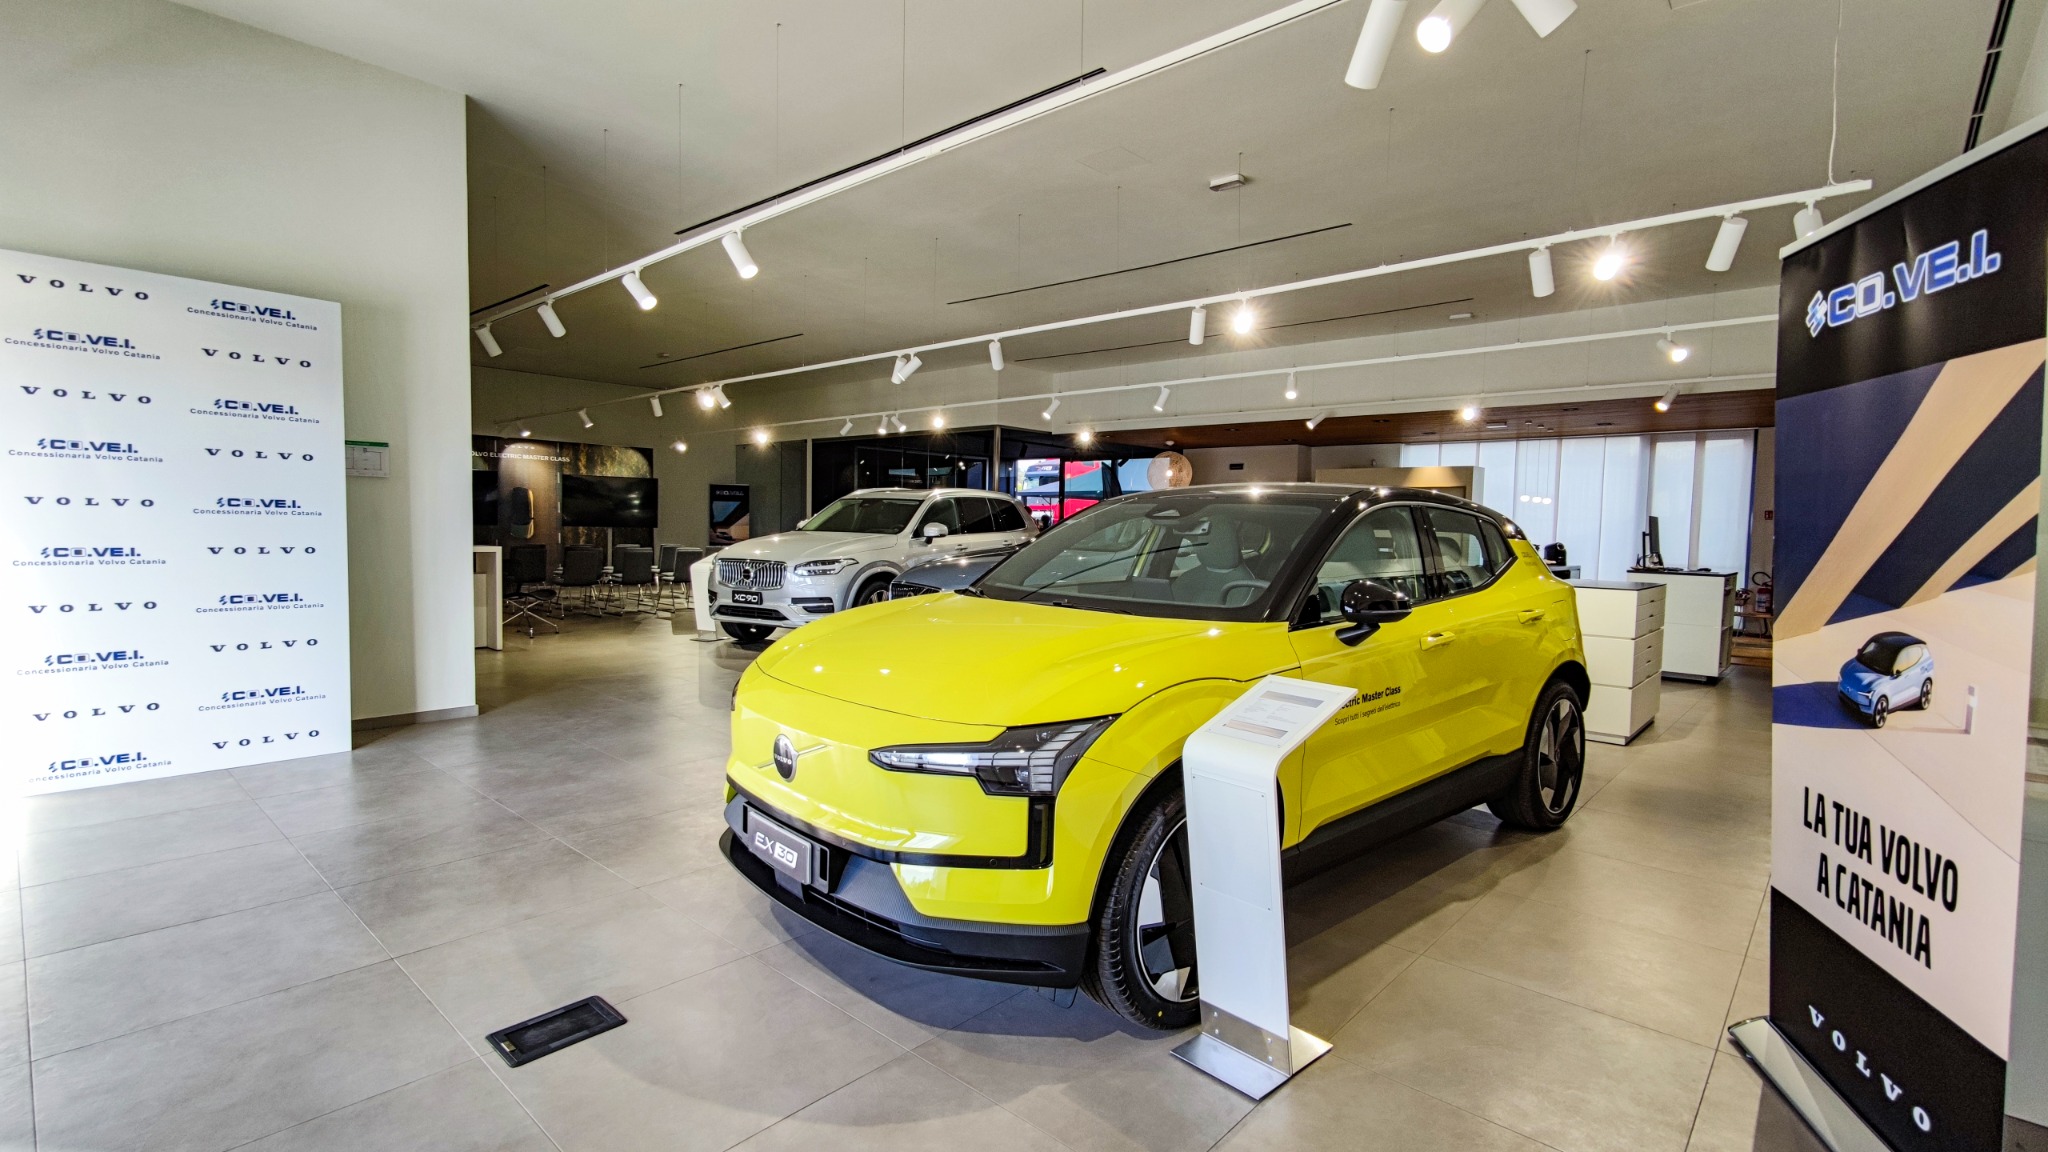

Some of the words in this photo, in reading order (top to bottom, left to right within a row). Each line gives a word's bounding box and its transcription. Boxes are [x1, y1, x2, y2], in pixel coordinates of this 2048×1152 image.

[1827, 229, 2001, 327] CO.VE.I.
[17, 274, 149, 301] VOLVO
[222, 300, 296, 321] CO.VE.I.
[187, 306, 256, 322] Concessionaria
[259, 318, 283, 326] Volvo
[286, 321, 317, 331] Catania
[47, 329, 136, 350] CO.VE.I.
[4, 337, 88, 352] Concessionaria
[92, 347, 120, 356] Volvo
[124, 351, 161, 360] Catania
[202, 348, 312, 368] VOLVO
[20, 385, 152, 404] VOLVO
[190, 408, 259, 419] Concessionaria
[224, 400, 298, 415] CO.VE.I.
[50, 439, 139, 453] CO.VE.I.
[8, 449, 91, 459] Concessionaria
[204, 448, 314, 462] VOLVO
[24, 496, 154, 507] VOLVO
[227, 498, 301, 508] CO.VE.I.
[53, 547, 141, 557] CO.VE.I.
[207, 546, 316, 555] VOLVO
[230, 594, 303, 604] CO.VE.I.
[734, 593, 758, 602] XC90
[28, 601, 157, 614] VOLVO
[196, 605, 264, 613] Concessionaria
[210, 638, 318, 652] VOLVO
[57, 650, 144, 664] CO.VE.I.
[17, 665, 98, 675] Concessionaria
[232, 686, 305, 700] CO.VE.I.
[1362, 690, 1383, 703] Master
[1385, 686, 1400, 696] Class
[199, 700, 266, 711] Concessionaria
[295, 693, 326, 701] Catania
[33, 702, 160, 722] VOLVO
[1335, 714, 1349, 725] Scopri
[1350, 713, 1359, 721] tutti
[1362, 709, 1376, 718] segreti
[213, 730, 320, 749] VOLVO
[61, 752, 147, 771] CO.VE.I.
[774, 754, 792, 765] VOLVO
[26, 770, 101, 783] oncessionaria
[104, 764, 132, 773] Volvo
[136, 760, 172, 769] Catania
[1803, 786, 1827, 838] LA
[1833, 800, 1872, 865] TUA
[1880, 825, 1958, 913] VOLVO
[1817, 852, 1829, 899] A
[1836, 865, 1932, 969] CATANIA
[1808, 1004, 1932, 1132] VOLVO
